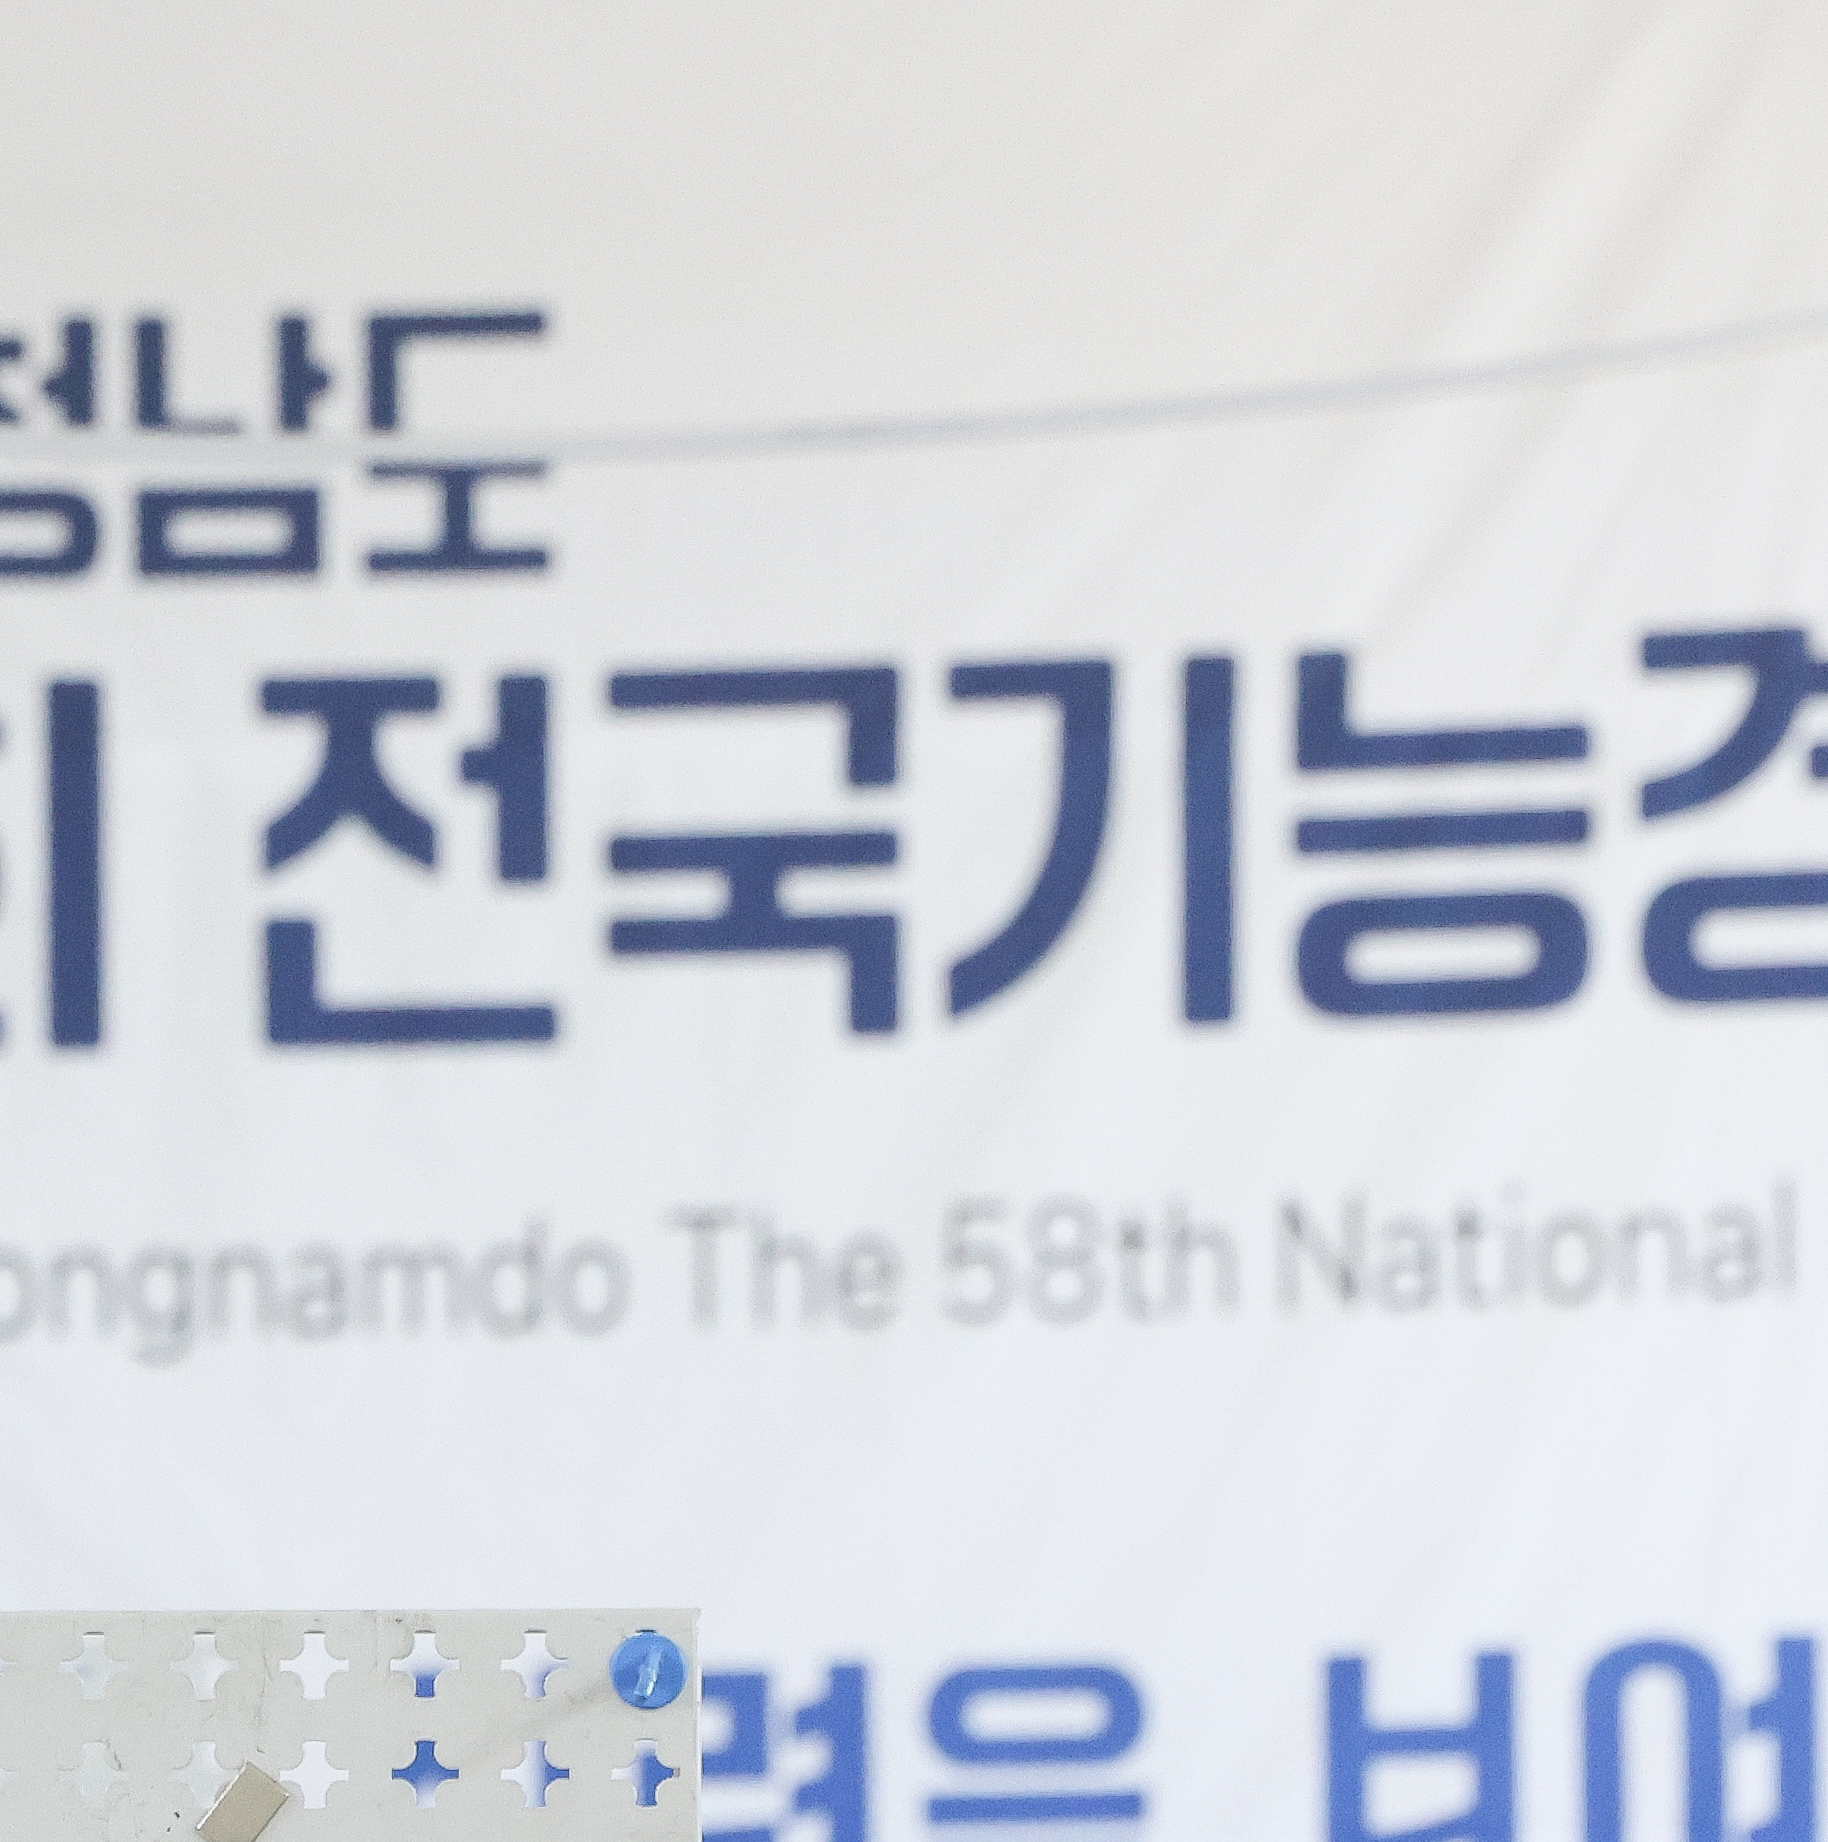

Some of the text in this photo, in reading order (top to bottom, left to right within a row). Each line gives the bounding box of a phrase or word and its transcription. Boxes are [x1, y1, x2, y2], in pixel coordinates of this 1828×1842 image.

[669, 1202, 904, 1334] The
[938, 1195, 1240, 1329] 58th
[1276, 1183, 1797, 1315] National
